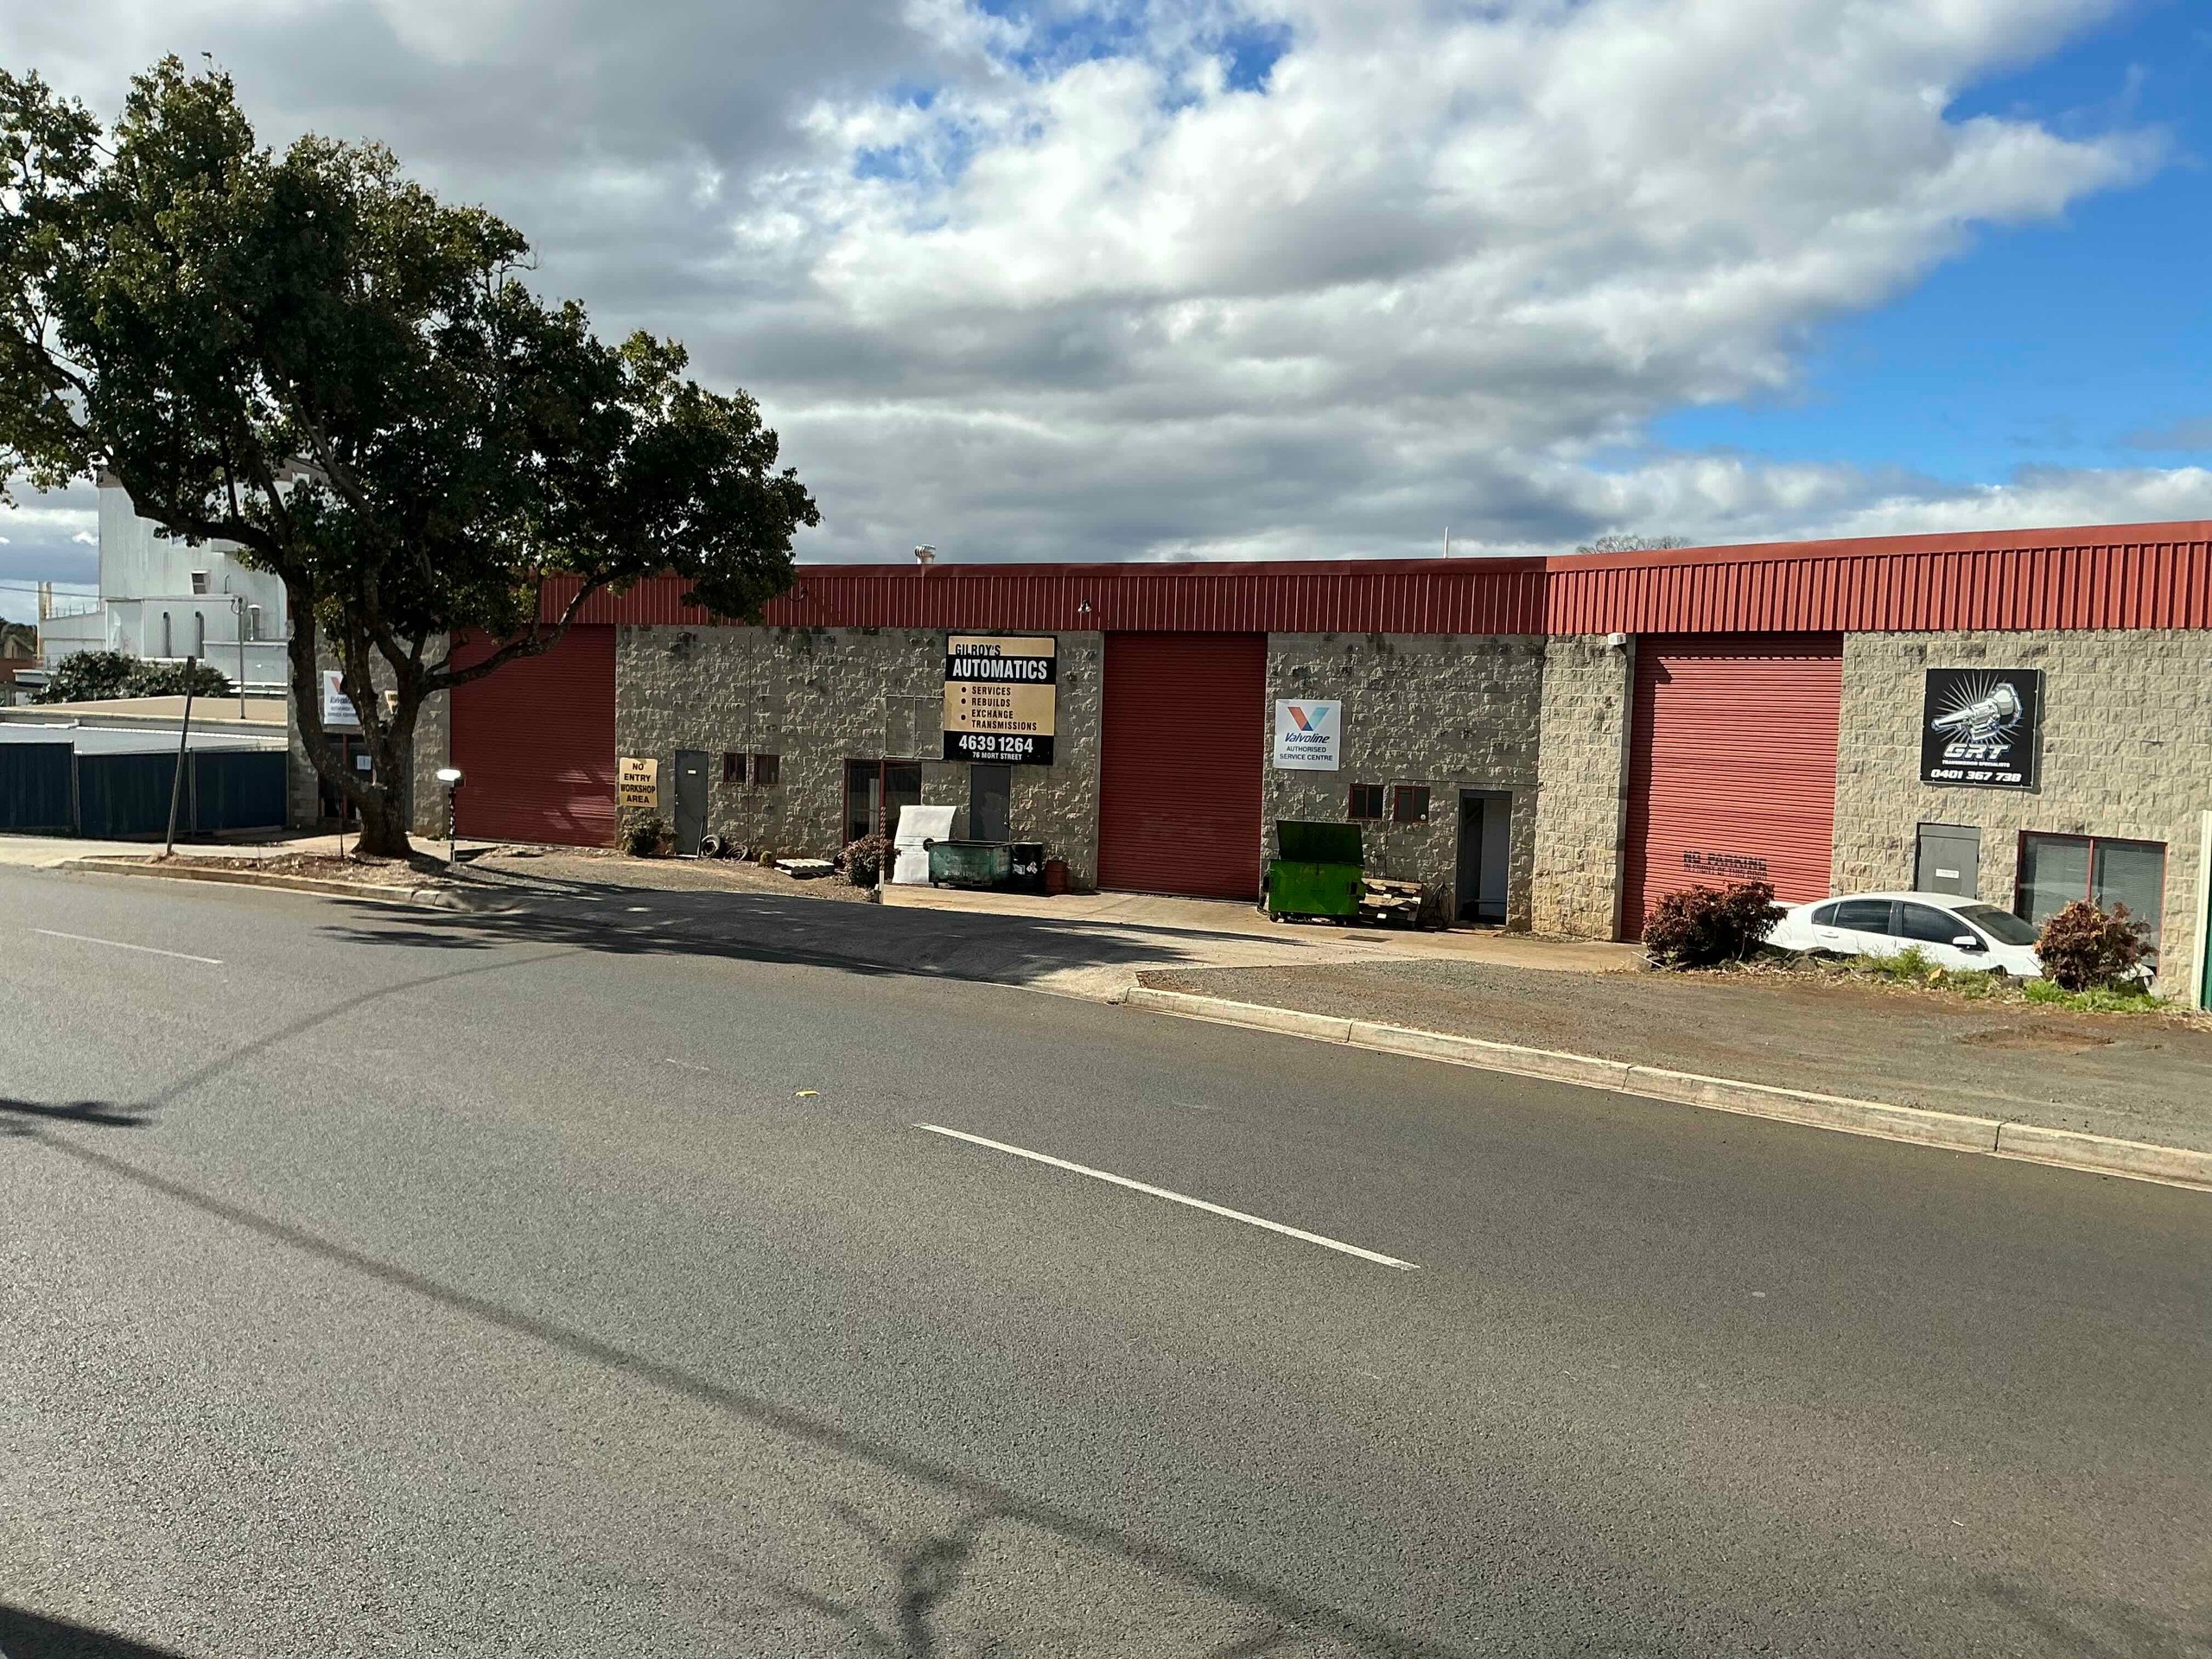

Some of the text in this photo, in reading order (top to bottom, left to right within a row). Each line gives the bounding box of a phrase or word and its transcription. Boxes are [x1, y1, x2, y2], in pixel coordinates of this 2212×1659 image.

[955, 644, 1001, 657] GILROY'S
[952, 658, 1047, 680] AUTOMATICS
[971, 686, 1011, 696] SERVICES
[971, 697, 1011, 708] REBUILDS
[971, 709, 1014, 719] EXCHANGE
[971, 720, 1037, 731] TRANSMISSIONS
[958, 734, 1033, 753] 4639 1264
[1284, 732, 1331, 744] Valvoline
[1943, 742, 2012, 760] GRT
[624, 773, 651, 782] ENTRY
[1931, 769, 2022, 782] 0401 367 738
[620, 784, 655, 793] WORKSHOP
[1683, 850, 1767, 871] NO PARKING
